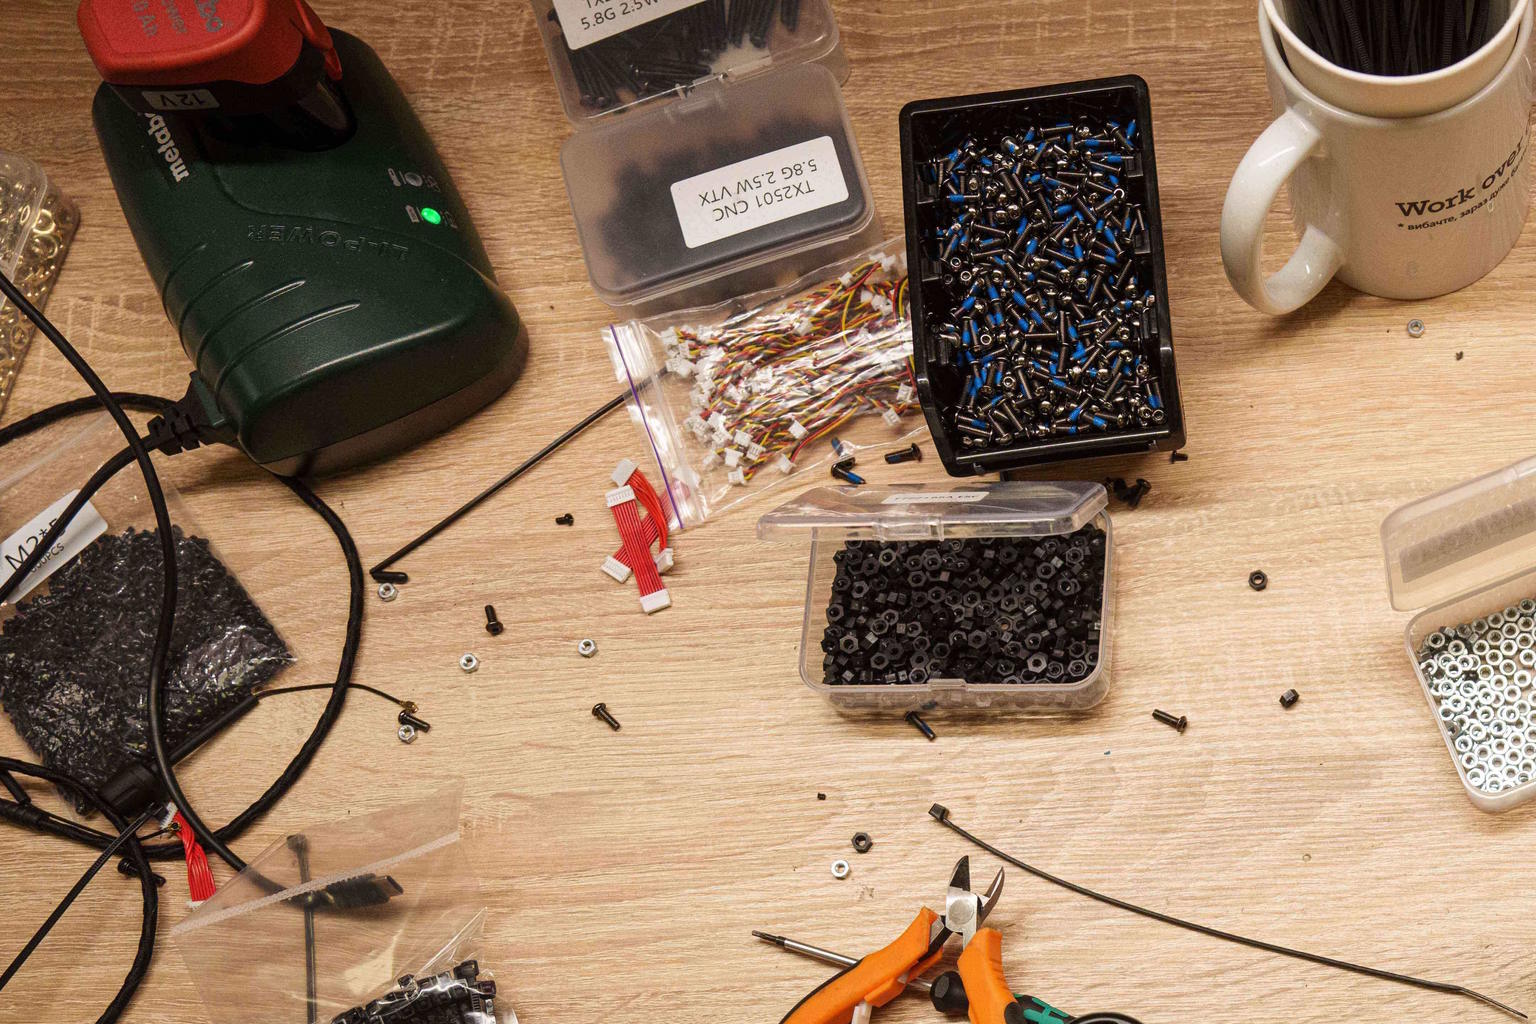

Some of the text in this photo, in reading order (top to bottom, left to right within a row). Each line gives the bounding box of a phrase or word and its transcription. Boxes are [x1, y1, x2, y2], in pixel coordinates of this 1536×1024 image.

[580, 7, 616, 30] 5.8G
[160, 91, 205, 108] 12V
[144, 112, 189, 182] metab
[699, 158, 817, 207] 5.8G 2.5W VTX
[712, 180, 815, 222] TX2501 CNC
[1395, 187, 1476, 217] Work
